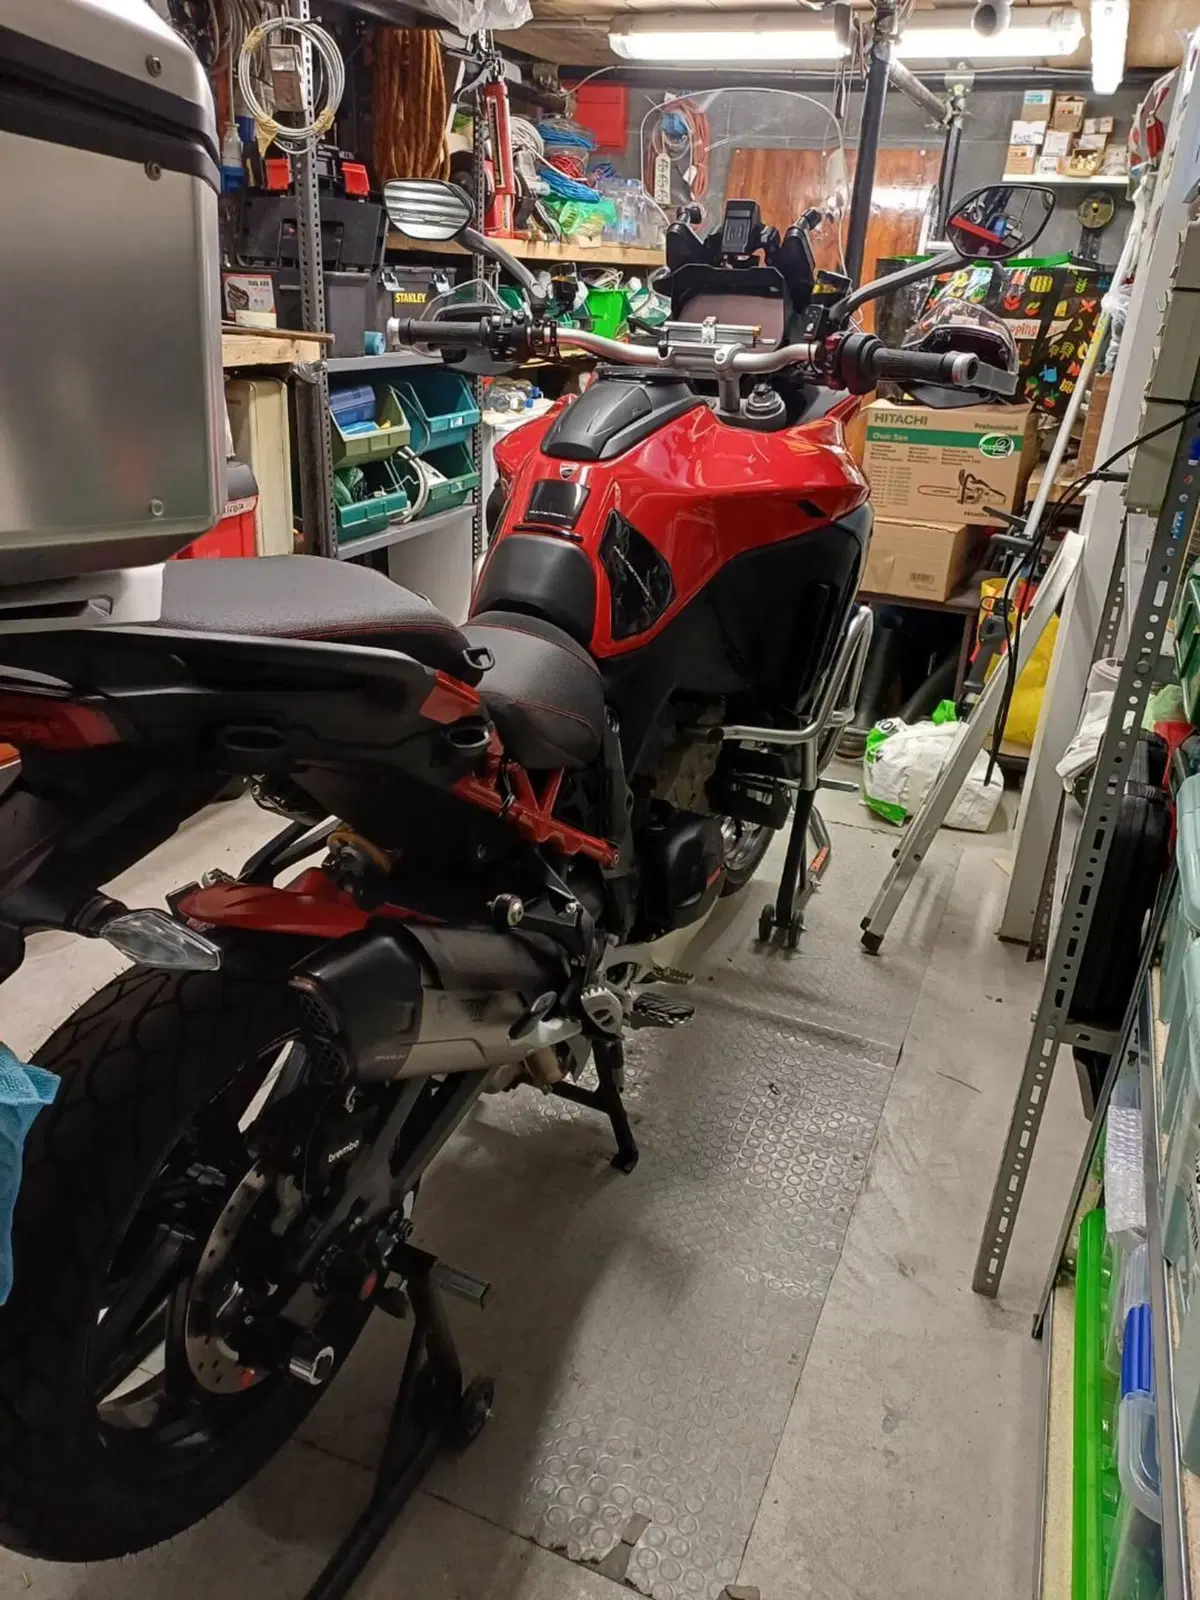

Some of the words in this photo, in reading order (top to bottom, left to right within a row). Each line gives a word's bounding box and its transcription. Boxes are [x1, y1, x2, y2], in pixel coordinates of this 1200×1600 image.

[395, 292, 427, 303] STANLEY
[874, 412, 928, 426] HITACHI
[974, 422, 1019, 431] Professional
[328, 1139, 360, 1163] brembo
